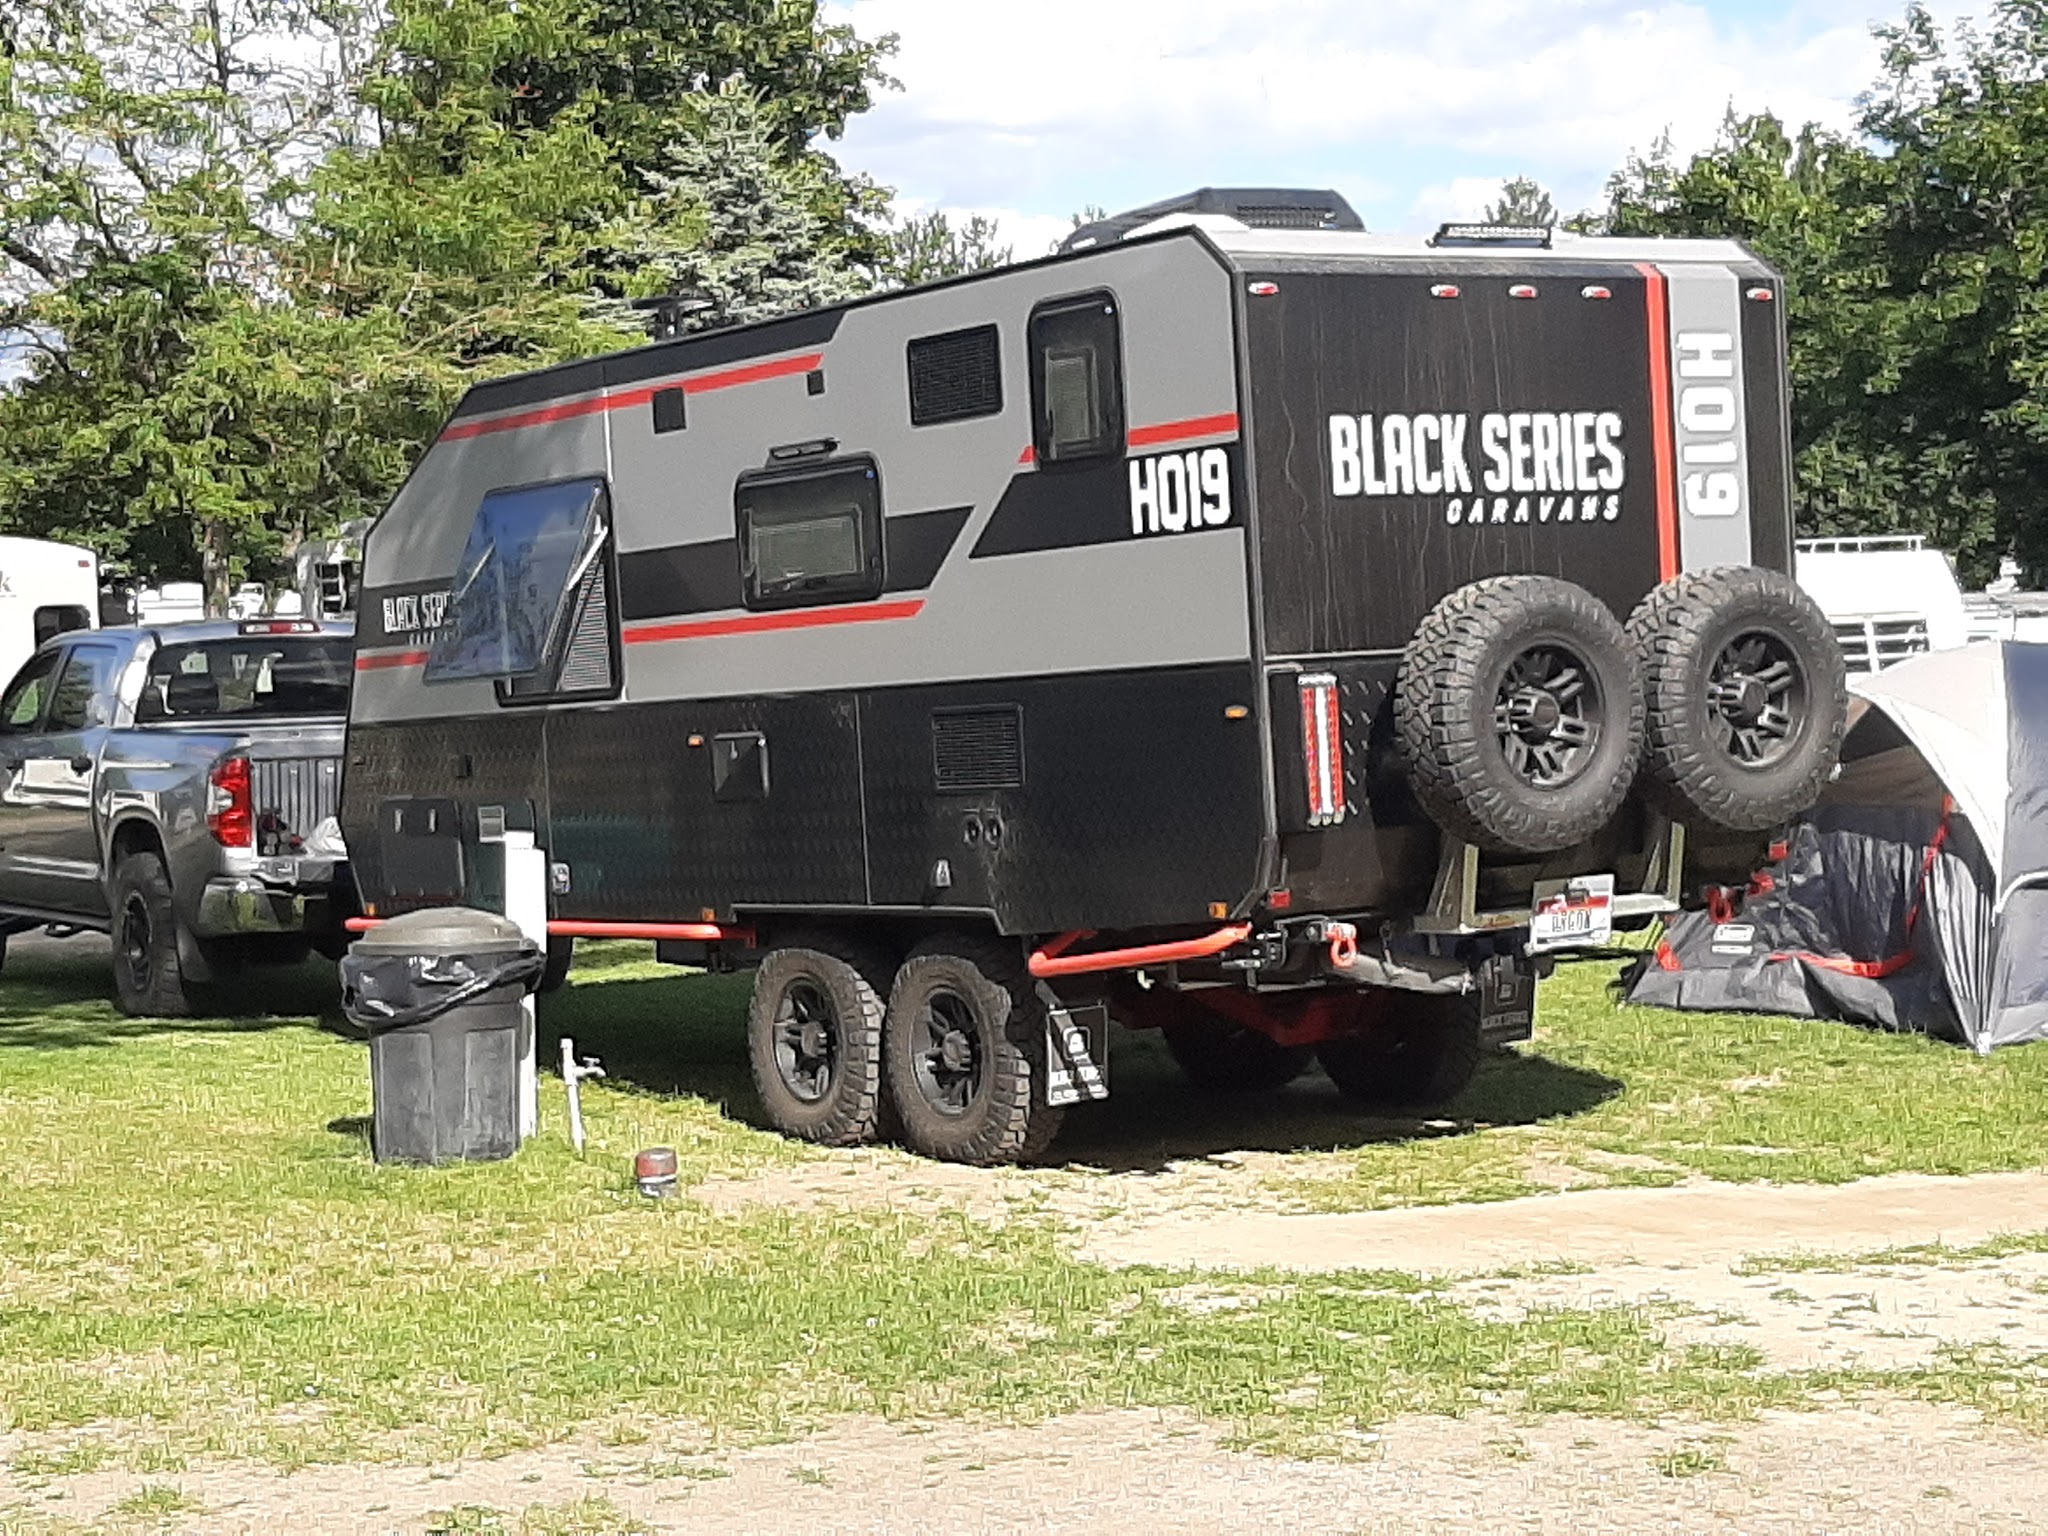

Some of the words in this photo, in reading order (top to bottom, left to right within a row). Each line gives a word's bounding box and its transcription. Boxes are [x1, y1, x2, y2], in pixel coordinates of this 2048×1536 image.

[1329, 413, 1473, 495] BLACK
[1481, 412, 1624, 492] SERIES
[1446, 495, 1620, 524] CARAVANS
